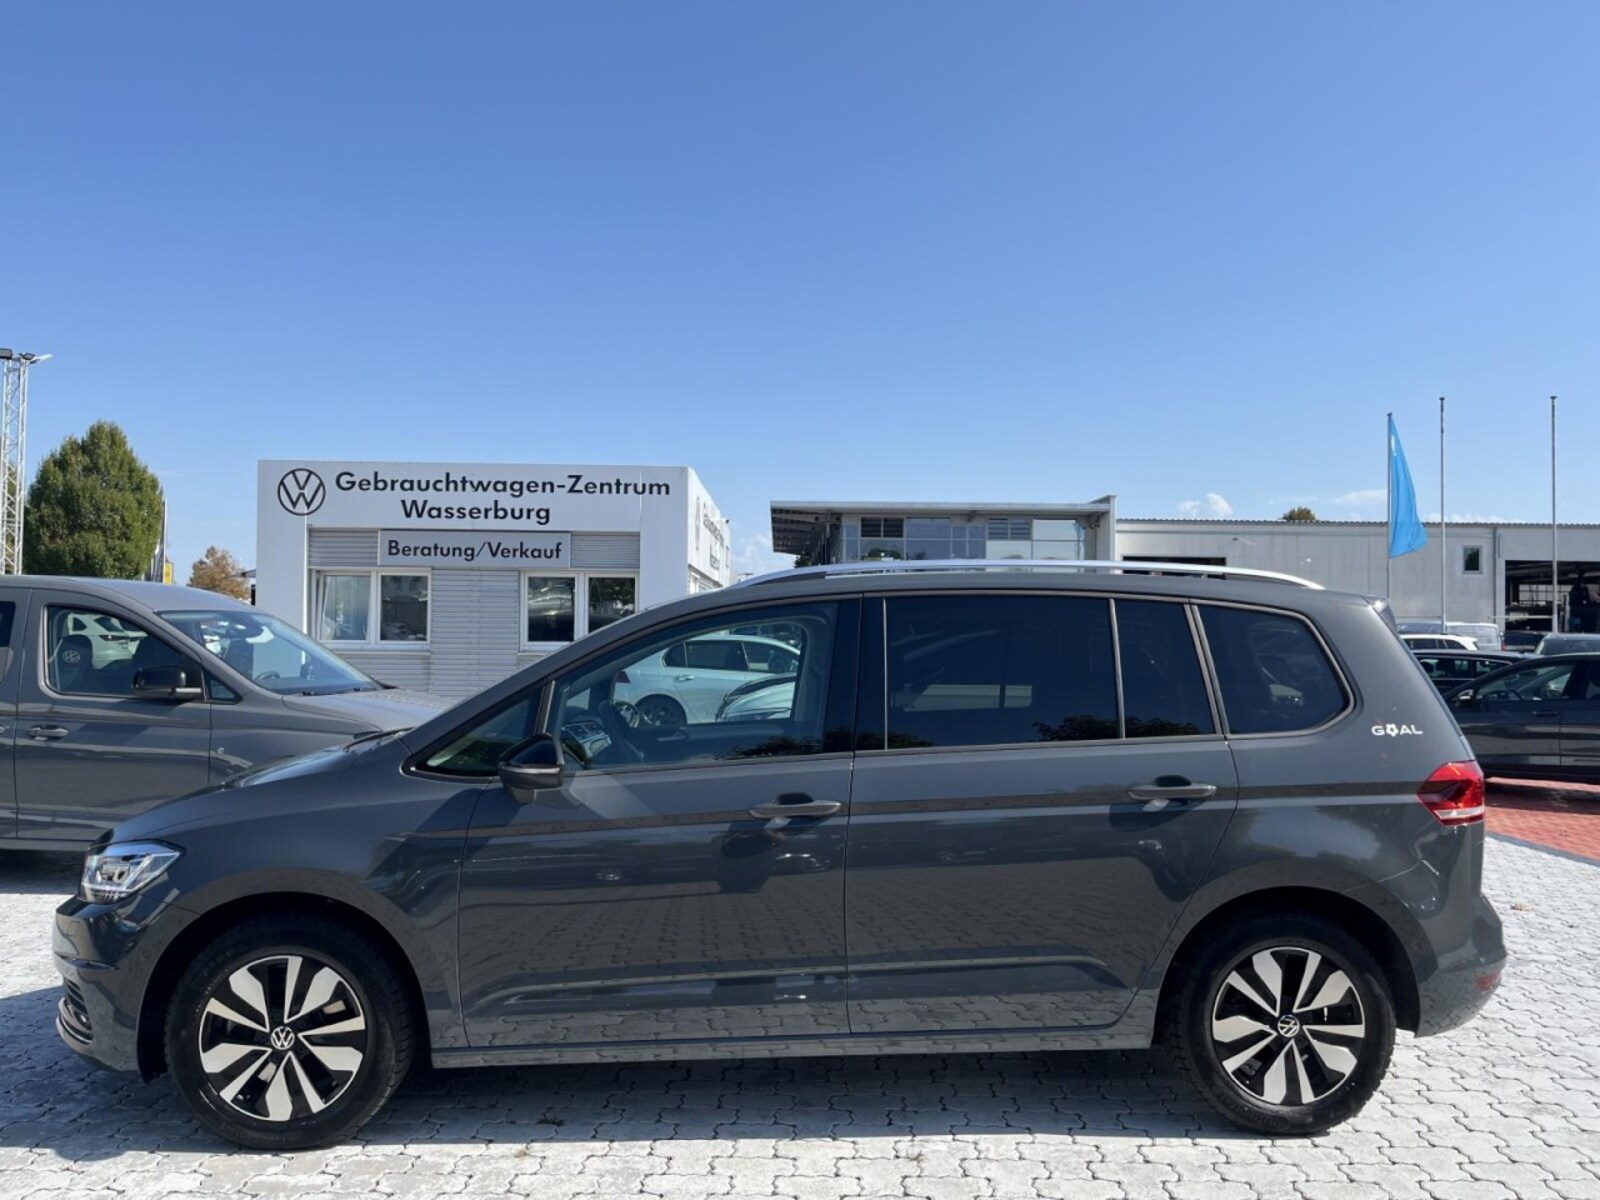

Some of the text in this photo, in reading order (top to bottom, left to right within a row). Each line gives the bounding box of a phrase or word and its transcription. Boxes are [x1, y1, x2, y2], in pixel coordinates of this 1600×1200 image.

[277, 468, 326, 516] VW
[335, 471, 671, 499] Gebrauchtwagen-Zentrum
[401, 500, 551, 526] Wasserburg
[387, 539, 563, 561] Beratung/Verkauf
[1371, 723, 1424, 738] GOAL
